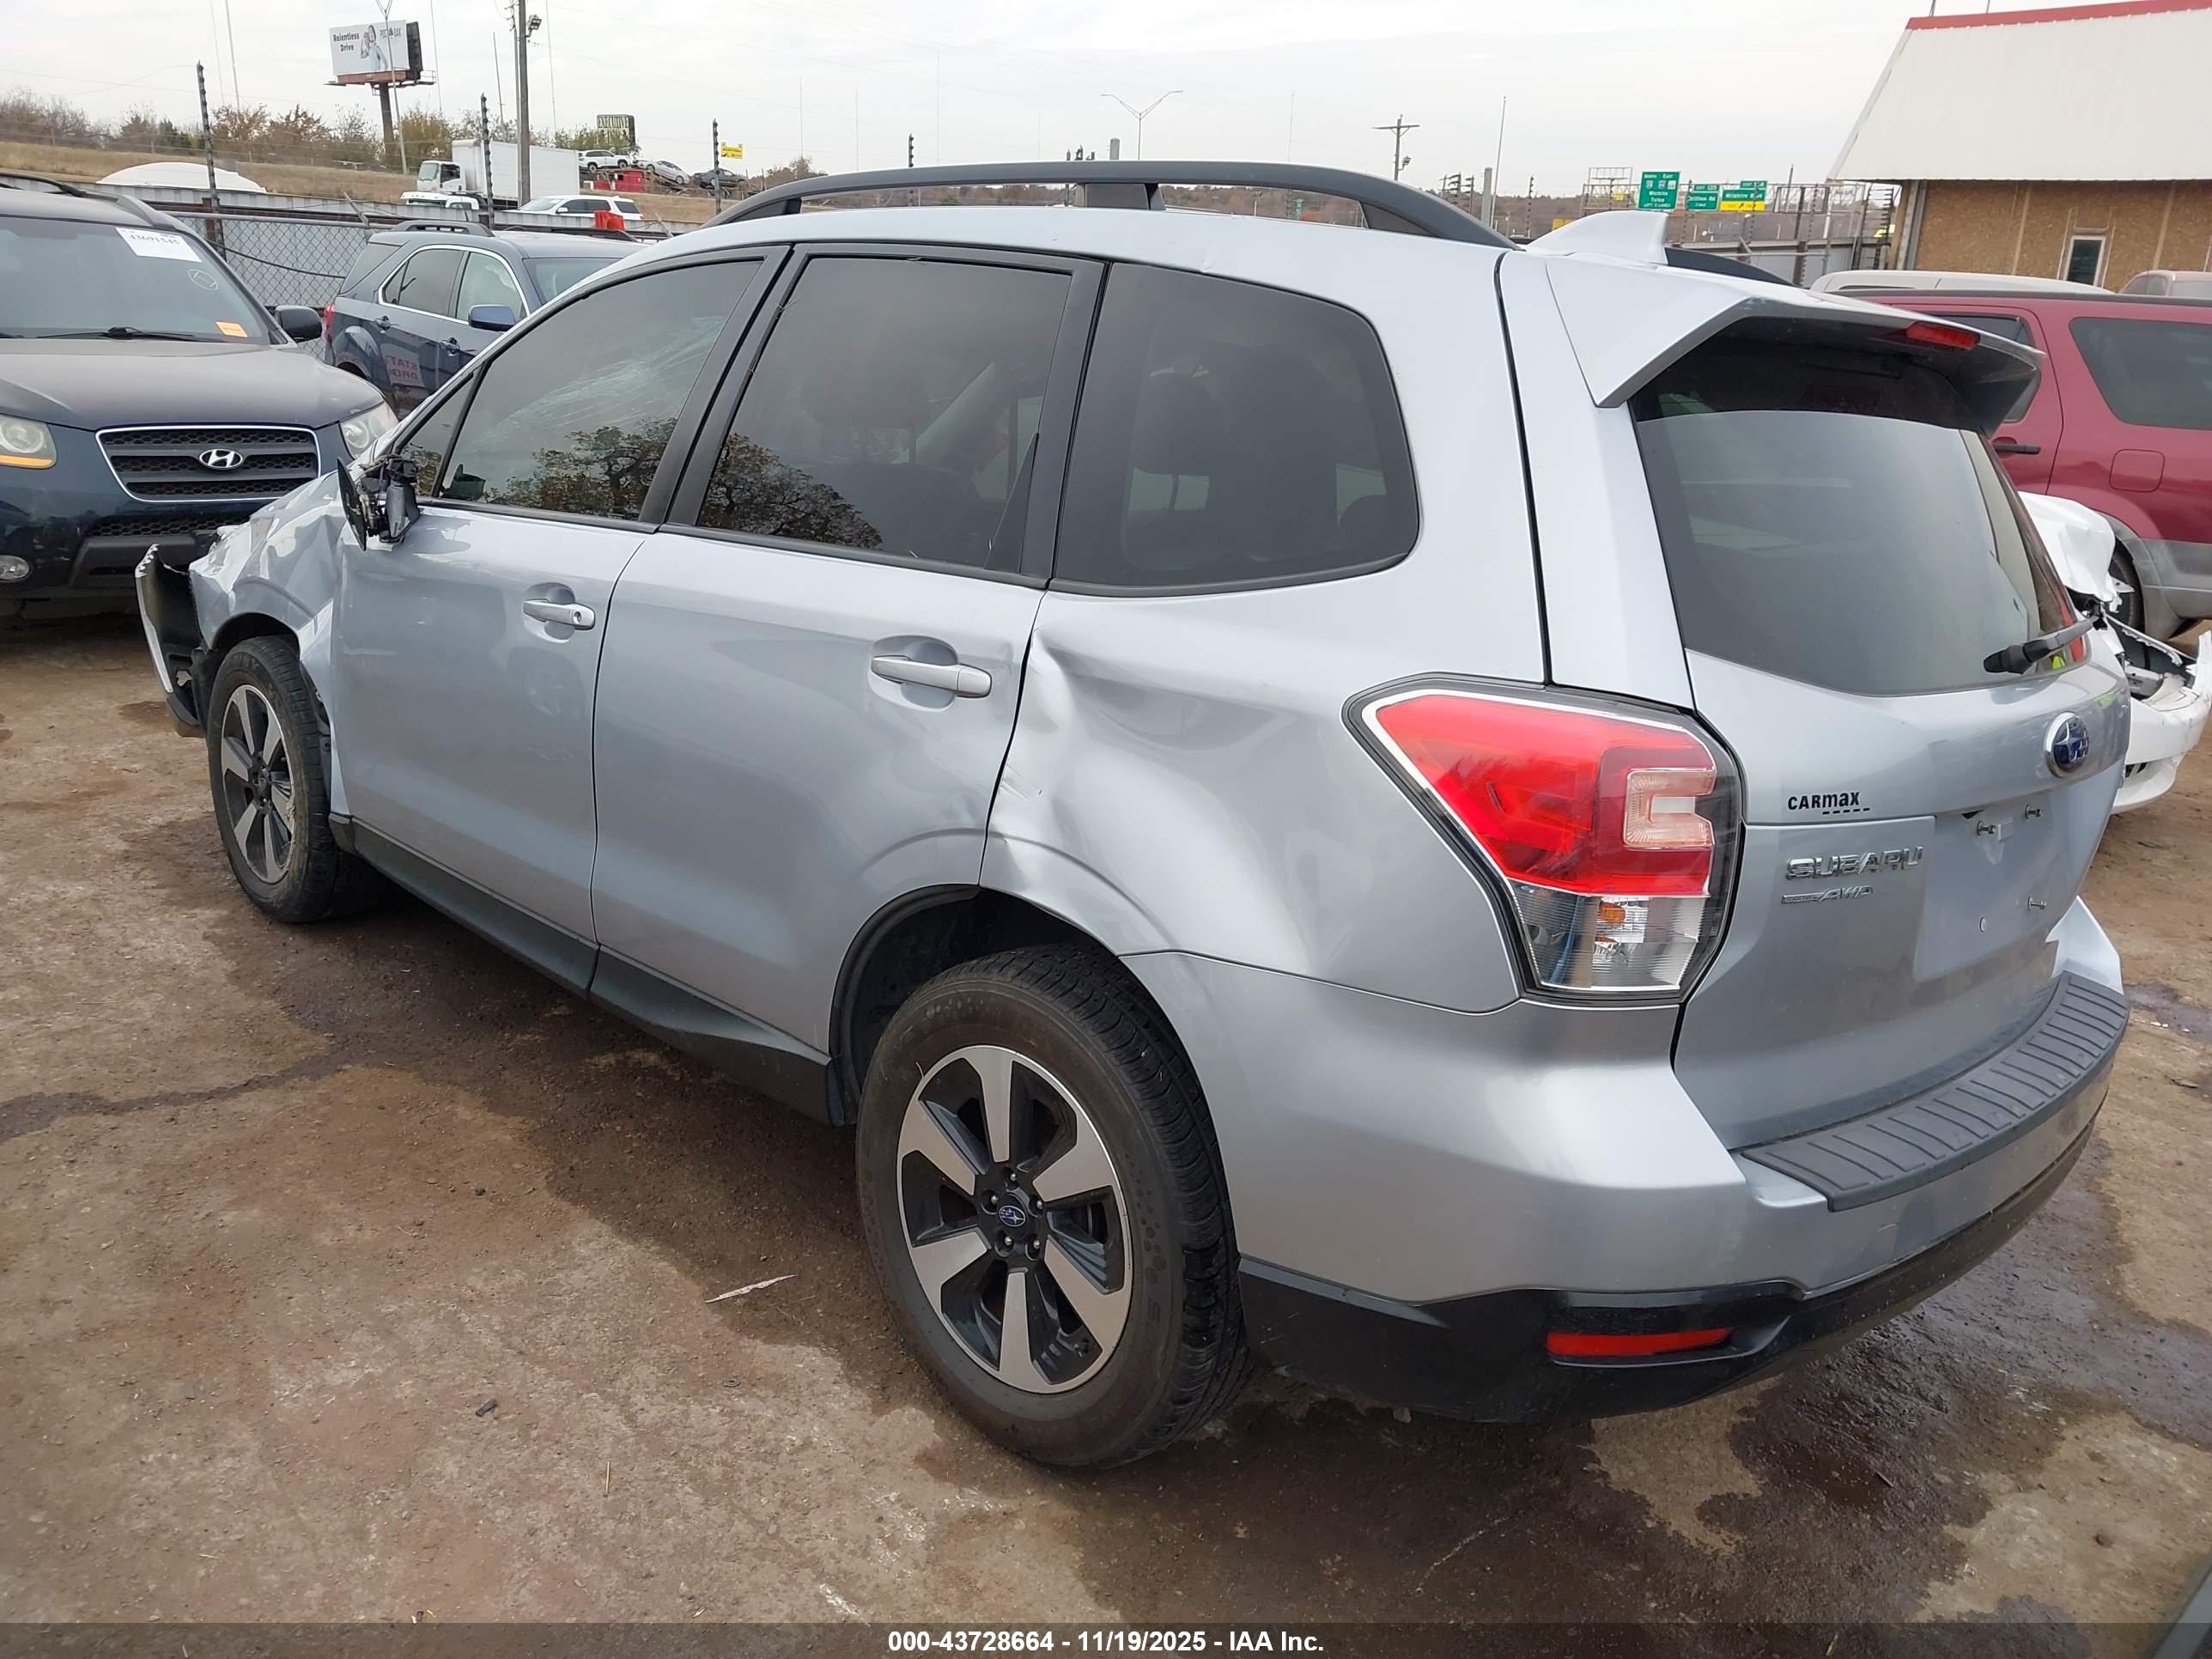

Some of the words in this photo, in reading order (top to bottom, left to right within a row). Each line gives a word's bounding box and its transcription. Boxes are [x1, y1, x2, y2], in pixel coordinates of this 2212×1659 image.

[333, 33, 360, 41] Relentless
[598, 115, 629, 129] EXECUTIVE
[1785, 846, 1923, 880] SUBARU
[1819, 884, 1875, 902] AWD
